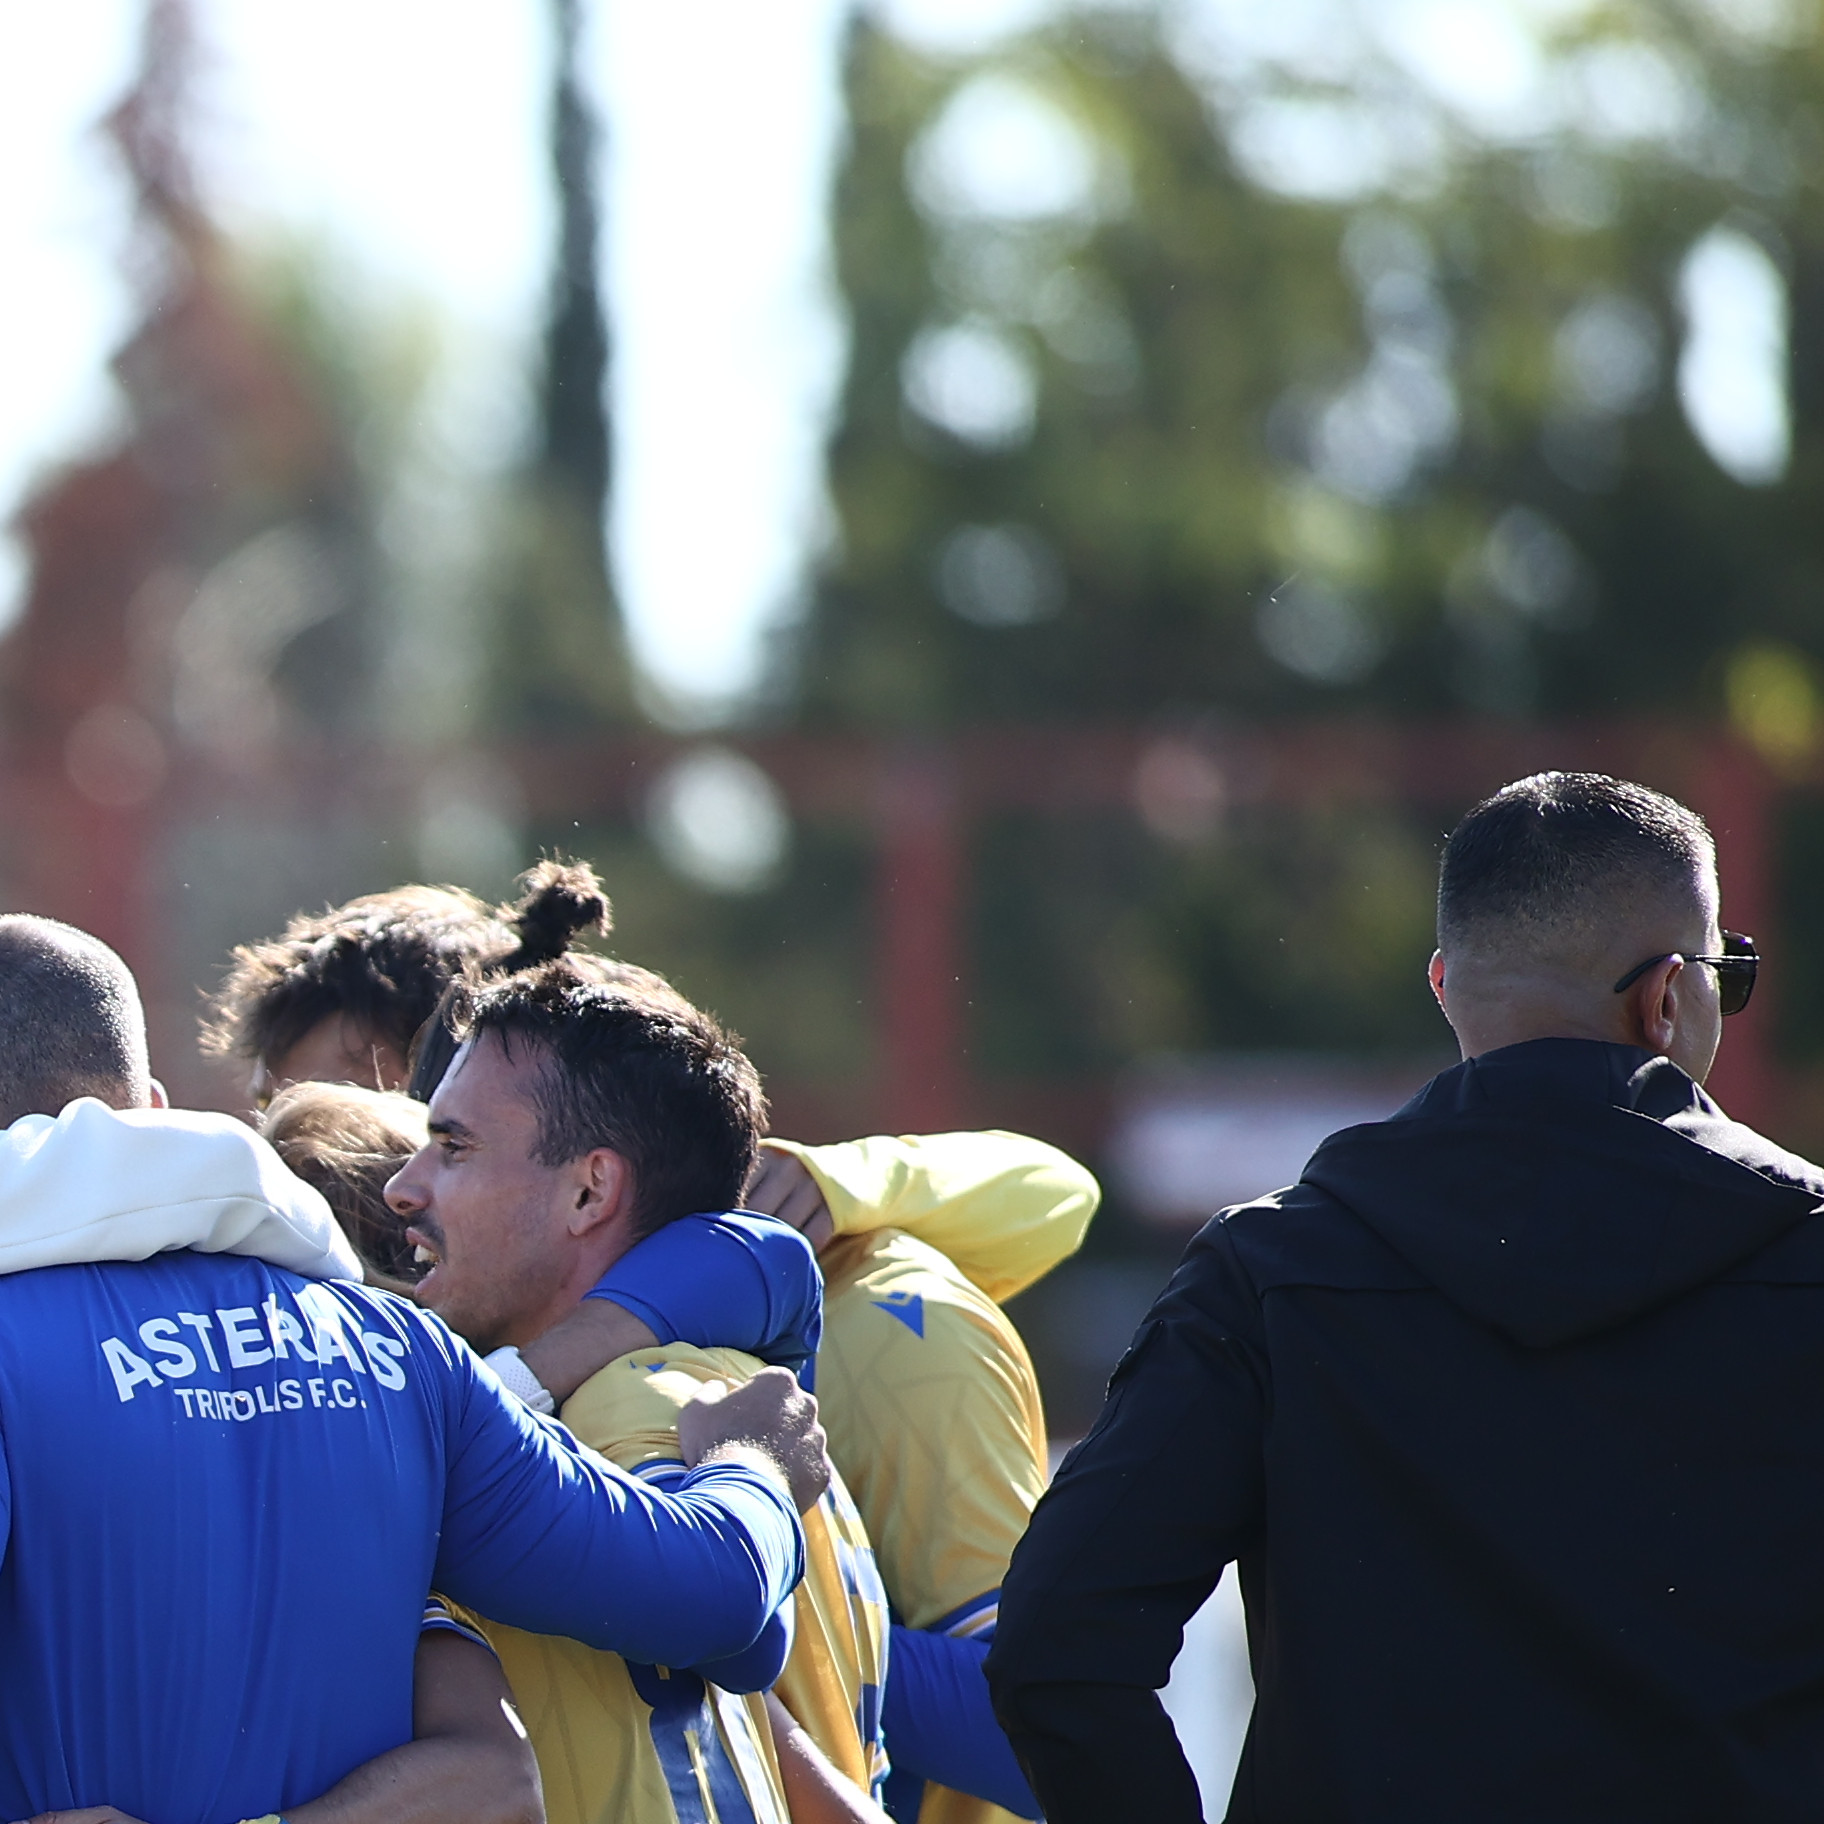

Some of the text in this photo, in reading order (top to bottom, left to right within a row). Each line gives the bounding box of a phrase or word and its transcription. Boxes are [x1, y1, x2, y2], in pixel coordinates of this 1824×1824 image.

[101, 1300, 407, 1403] ASTERAS
[174, 1378, 367, 1422] TRIPOLIS F.C.
